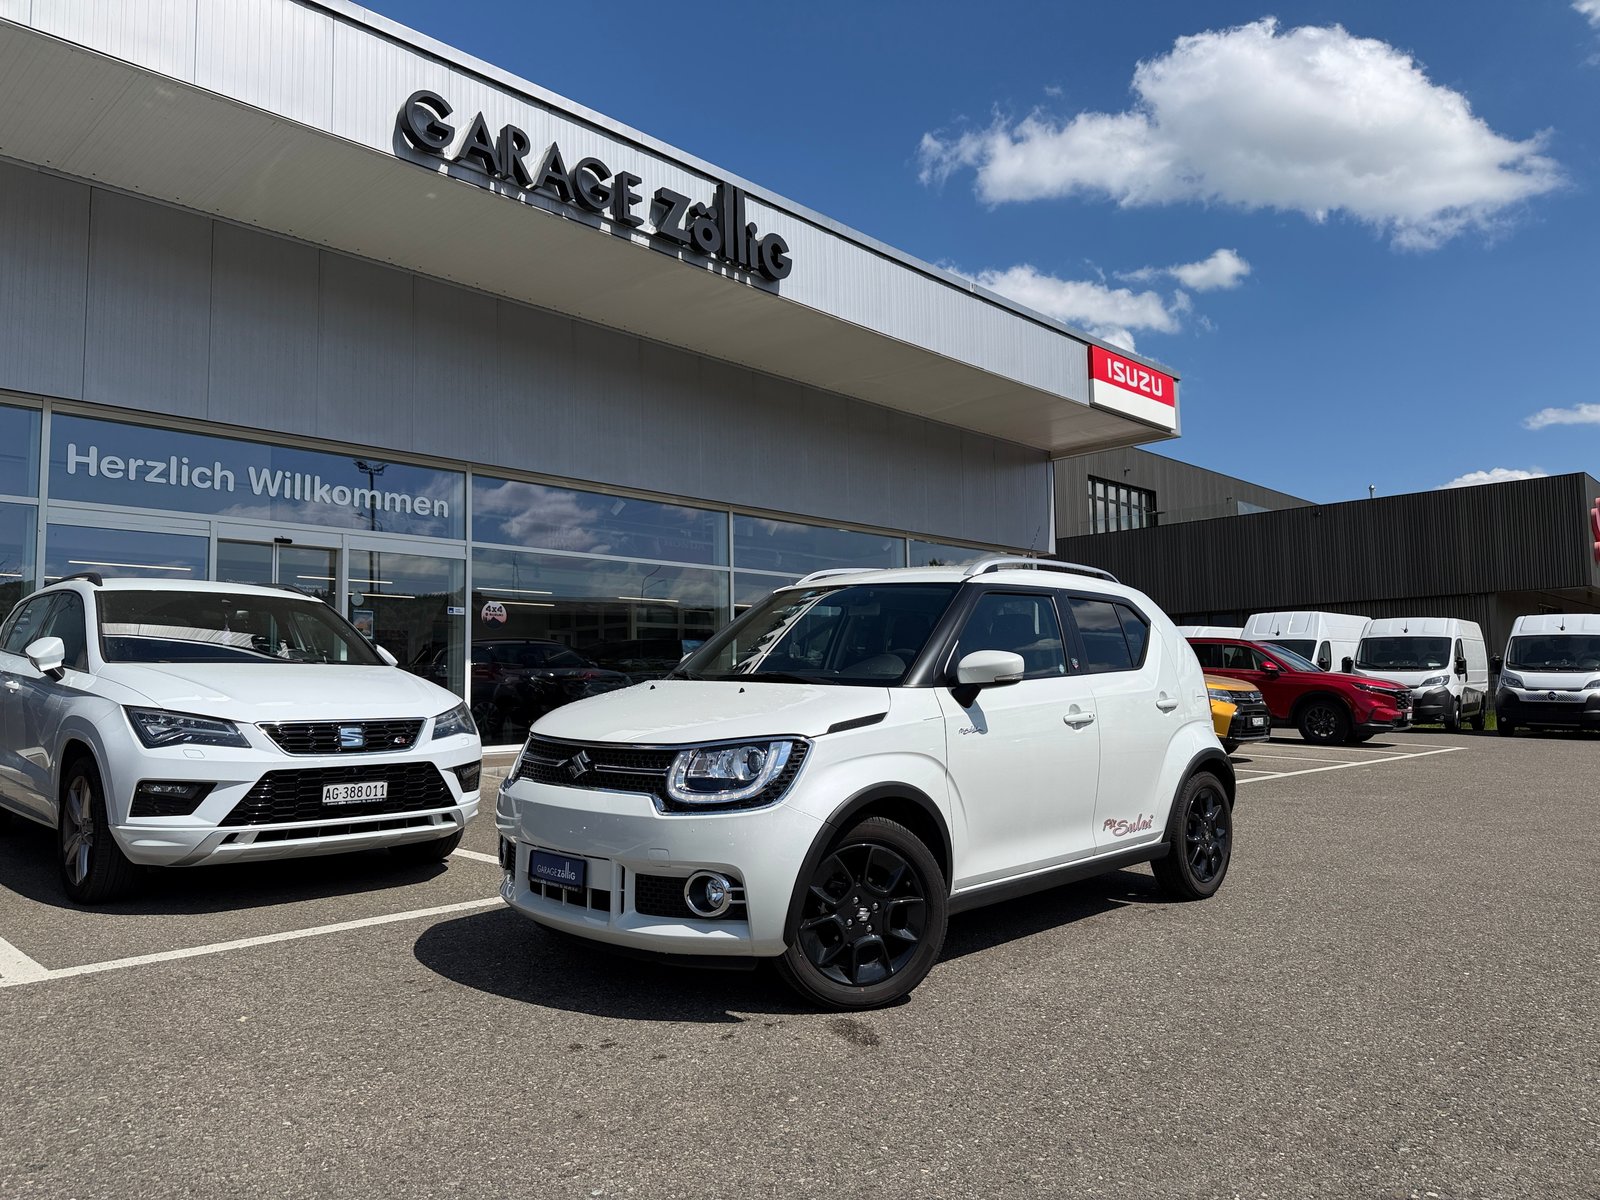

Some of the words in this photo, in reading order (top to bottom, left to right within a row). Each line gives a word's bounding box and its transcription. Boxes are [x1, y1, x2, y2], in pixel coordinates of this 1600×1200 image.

[400, 90, 644, 228] GARAGE
[1107, 358, 1163, 397] ISUZU
[67, 443, 235, 492] Herzlich
[248, 466, 449, 518] Willkommen
[485, 605, 502, 613] 4x4
[537, 864, 557, 877] GARAGE
